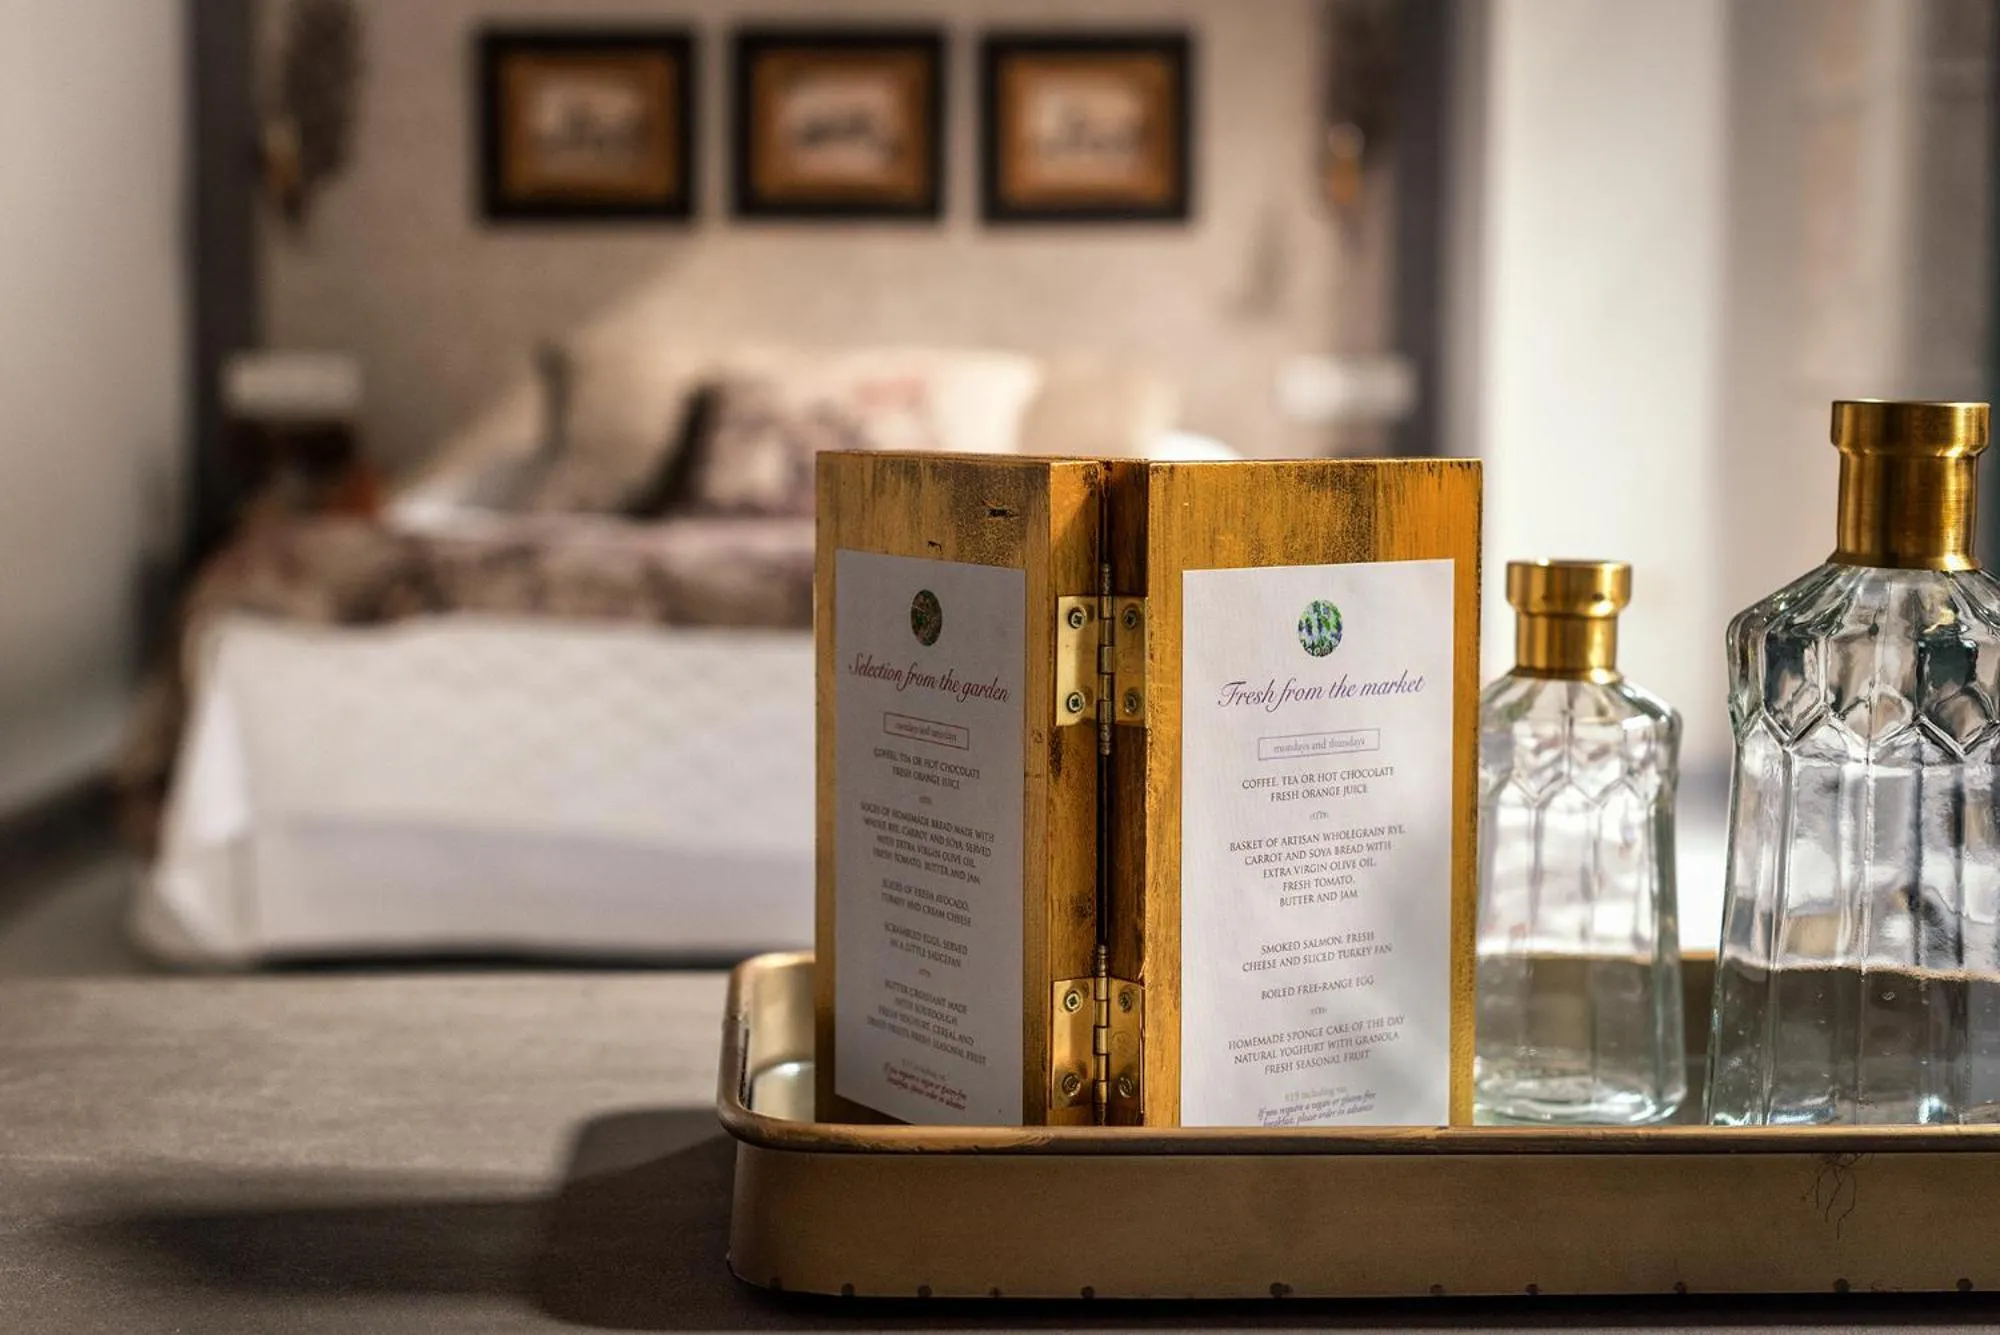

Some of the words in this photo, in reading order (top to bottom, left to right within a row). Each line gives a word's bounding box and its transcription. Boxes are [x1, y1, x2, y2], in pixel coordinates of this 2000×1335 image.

[849, 654, 901, 680] Selection
[897, 663, 935, 691] from
[938, 669, 957, 692] the
[957, 678, 1009, 702] garden
[1218, 679, 1276, 706] Fresh
[1266, 678, 1323, 712] from
[1329, 674, 1358, 698] the
[1359, 670, 1425, 695] market
[1312, 737, 1326, 750] and
[941, 762, 980, 778] CHOCOLATE
[1281, 776, 1298, 785] TEA
[1301, 774, 1314, 783] OR
[1318, 772, 1337, 782] HOT
[1340, 767, 1394, 780] CHOCOLATE
[1271, 792, 1298, 802] FRESH
[1302, 788, 1340, 799] ORANGE
[1343, 785, 1368, 797] JUICE
[930, 834, 945, 844] AND
[966, 844, 991, 856] SERVED
[1230, 840, 1262, 851] BASKET
[1266, 838, 1278, 847] OF
[1281, 834, 1320, 846] ARTISAN
[1323, 827, 1385, 841] WHOLEGRAIN
[1245, 853, 1282, 865] CARROT
[1285, 851, 1305, 861] AND
[1309, 848, 1332, 858] SOYA
[1335, 844, 1364, 855] BREAD
[1366, 841, 1392, 851] WITH
[1264, 867, 1291, 878] EXTRA
[1294, 864, 1327, 875] VIRGIN
[1330, 861, 1358, 871] OLIVE
[1283, 880, 1311, 891] FRESH
[1280, 895, 1314, 907] BUTTER
[1317, 893, 1337, 903] AND
[1340, 890, 1358, 900] JAM
[1262, 942, 1300, 955] SMOKED
[1347, 932, 1375, 943] FRESH
[1242, 961, 1276, 972] CHEESE
[1280, 957, 1300, 967] AND
[1303, 953, 1335, 964] SLICED
[1338, 948, 1372, 959] TURKEY
[1262, 987, 1295, 999] BOILED
[1298, 979, 1352, 994] FREE-RANGE
[1356, 976, 1374, 986] EGG
[1228, 1034, 1284, 1049] HOMEMADE
[1287, 1028, 1323, 1042] SPONGE
[1326, 1024, 1349, 1034] CAKE
[1352, 1021, 1363, 1030] OF
[1367, 1018, 1385, 1028] THE
[1387, 1015, 1405, 1025] DAY
[1234, 1051, 1277, 1064] NATURAL
[1279, 1042, 1324, 1058] YOGHURT
[1328, 1039, 1353, 1049] WITH
[1356, 1032, 1399, 1045] GRANOLA
[1265, 1062, 1293, 1074] FRESH
[1296, 1055, 1340, 1070] SEASONAL
[1344, 1050, 1370, 1062] FRUIT
